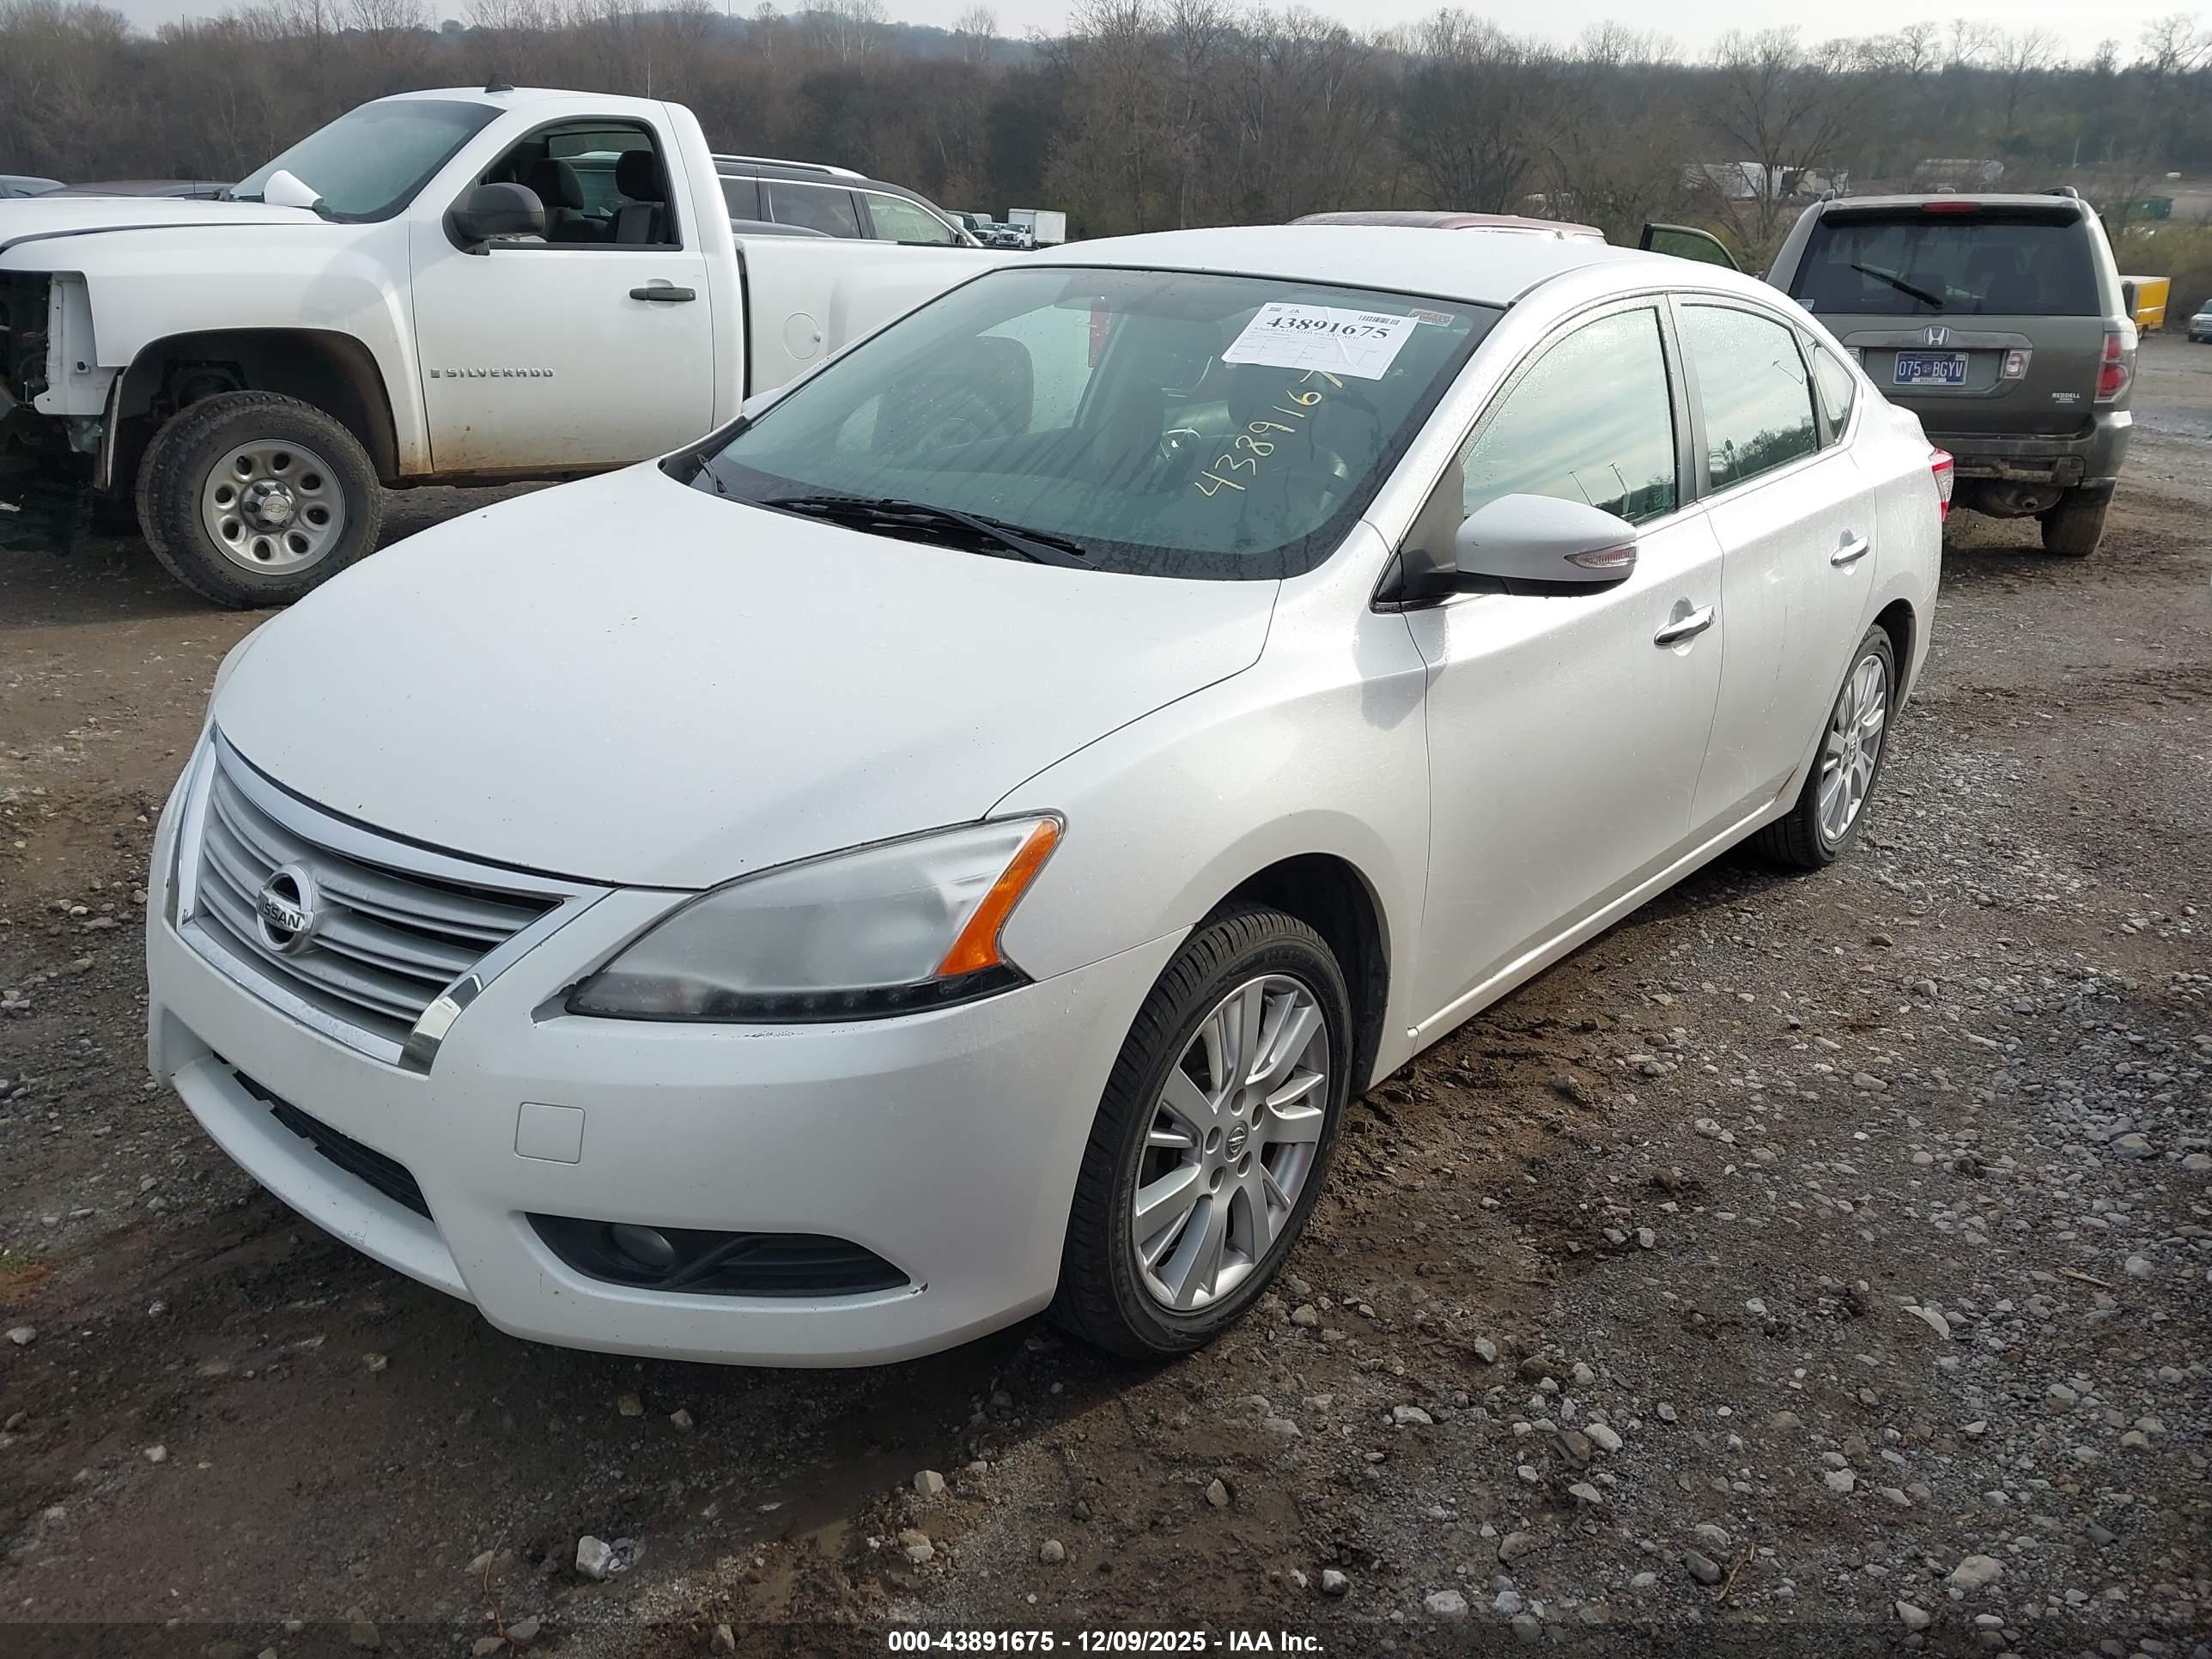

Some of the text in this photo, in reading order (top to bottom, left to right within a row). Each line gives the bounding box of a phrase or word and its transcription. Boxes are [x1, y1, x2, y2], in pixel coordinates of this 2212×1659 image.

[1266, 316, 1391, 339] 43891675
[447, 368, 554, 378] SILVERADO
[1898, 361, 1964, 377] 075 BGYV
